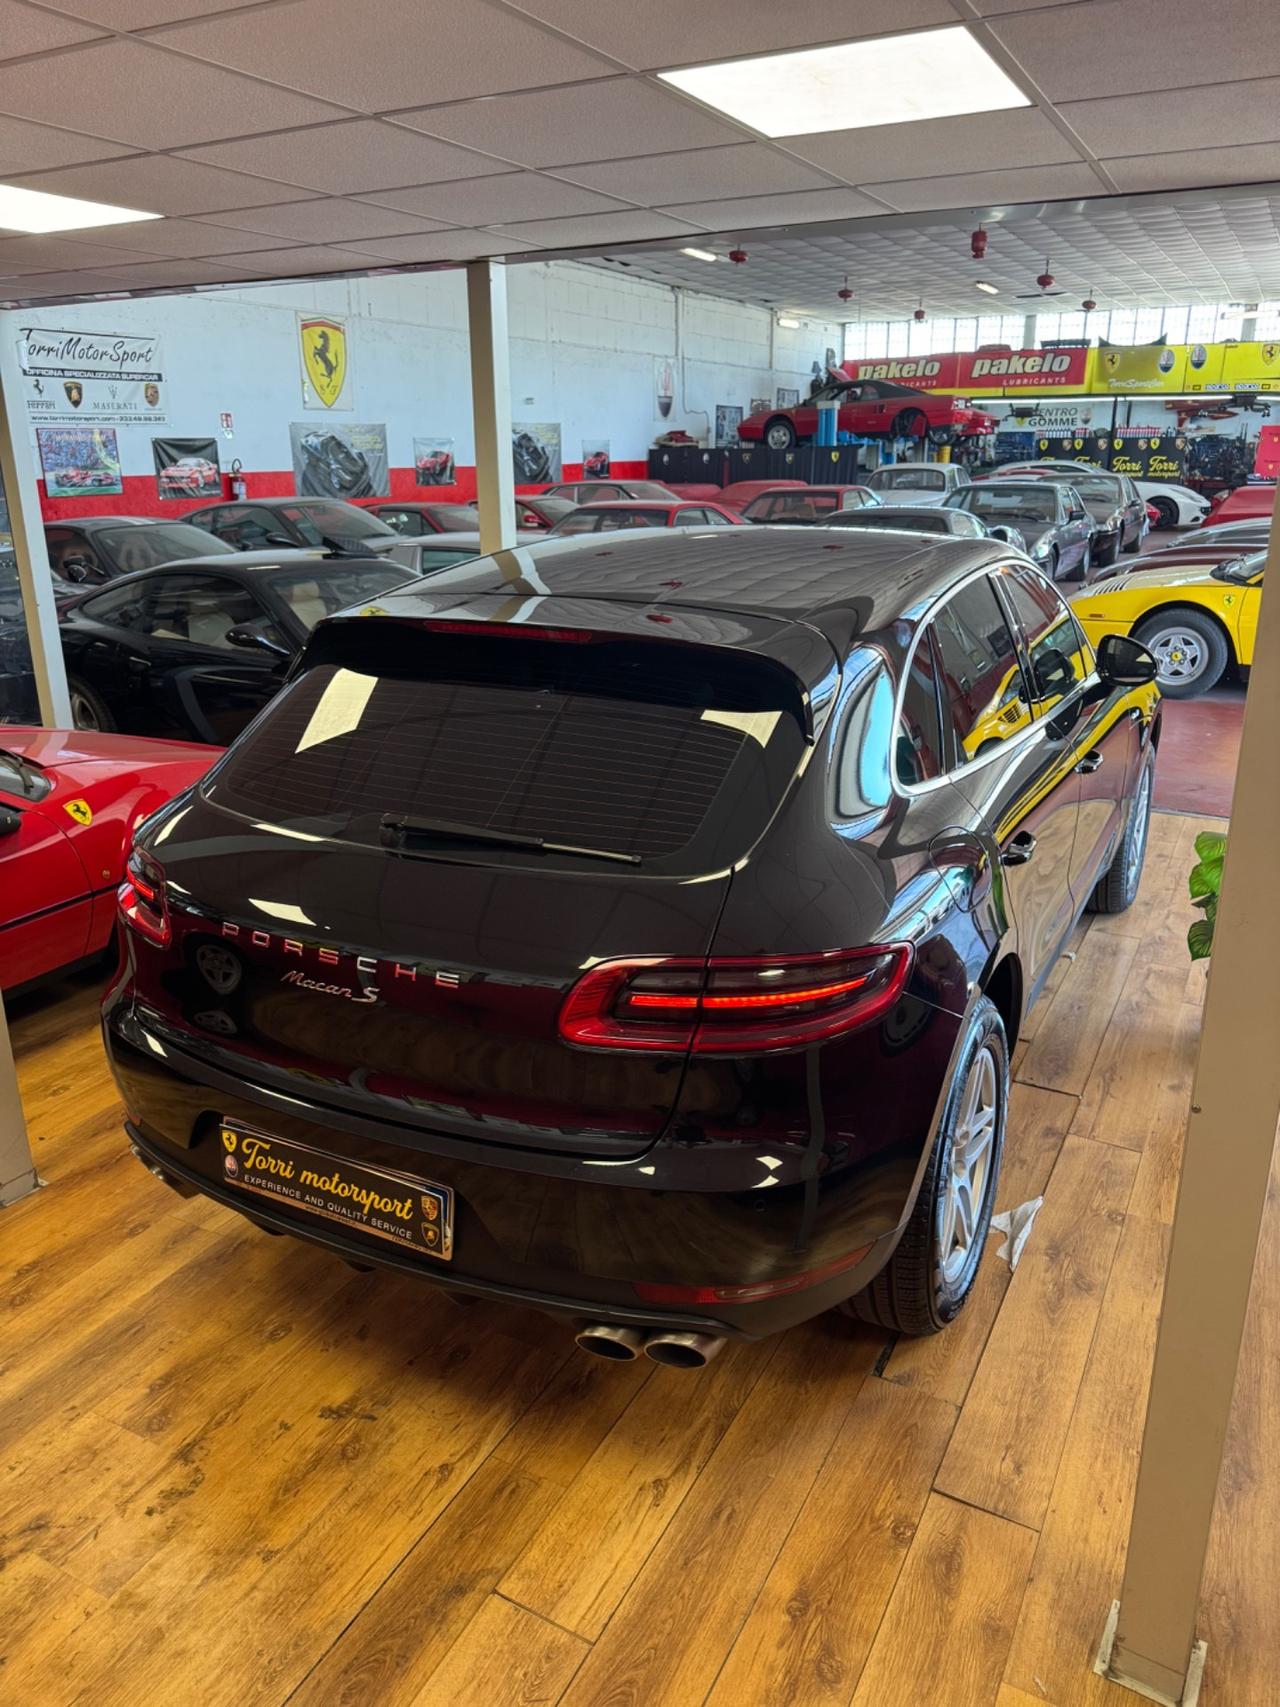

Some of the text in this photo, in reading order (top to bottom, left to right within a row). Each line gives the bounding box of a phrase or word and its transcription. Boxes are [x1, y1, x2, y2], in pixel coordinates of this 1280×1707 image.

[858, 359, 941, 380] pakelo
[971, 352, 1071, 379] pakelo
[26, 369, 158, 381] OFFICINA SPECIALIZZATA SUPERCAR
[1002, 377, 1066, 386] LUBRICANTS
[27, 400, 56, 410] Ferrari
[93, 402, 138, 410] MASERATI
[1039, 407, 1078, 417] ENTRO
[1028, 416, 1078, 427] GOMME
[1112, 456, 1142, 472] Torri
[1149, 456, 1179, 472] Torri
[221, 921, 460, 989] PORSCHE
[280, 970, 380, 1003] Macan S
[241, 1138, 295, 1180] Torri
[299, 1169, 414, 1221] motorsport
[244, 1174, 302, 1200] EXPERIENCE
[304, 1193, 325, 1207] AND
[327, 1201, 368, 1223] QUALITY
[371, 1217, 413, 1241] SERVICE
